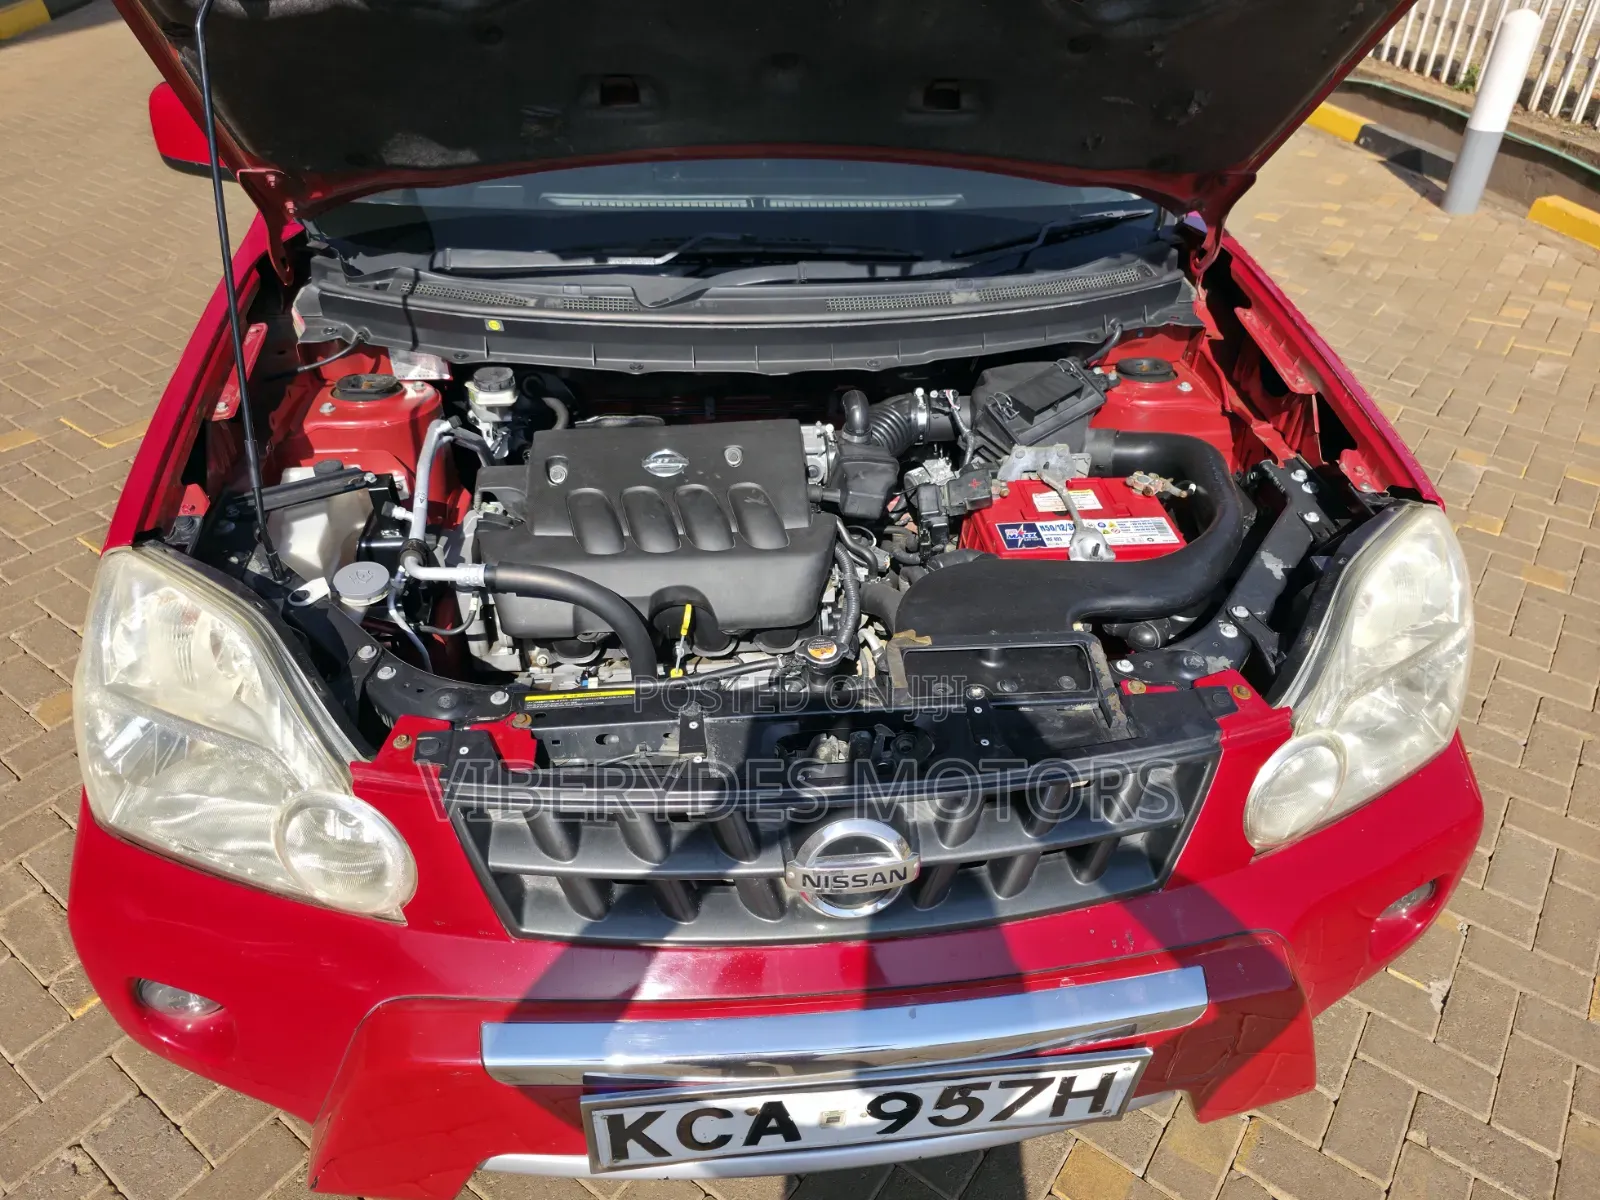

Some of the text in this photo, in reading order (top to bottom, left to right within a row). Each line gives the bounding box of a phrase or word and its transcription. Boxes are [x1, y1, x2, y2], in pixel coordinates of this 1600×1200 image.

[802, 866, 908, 889] NISSAN
[606, 1070, 1118, 1160] KCA 957H
